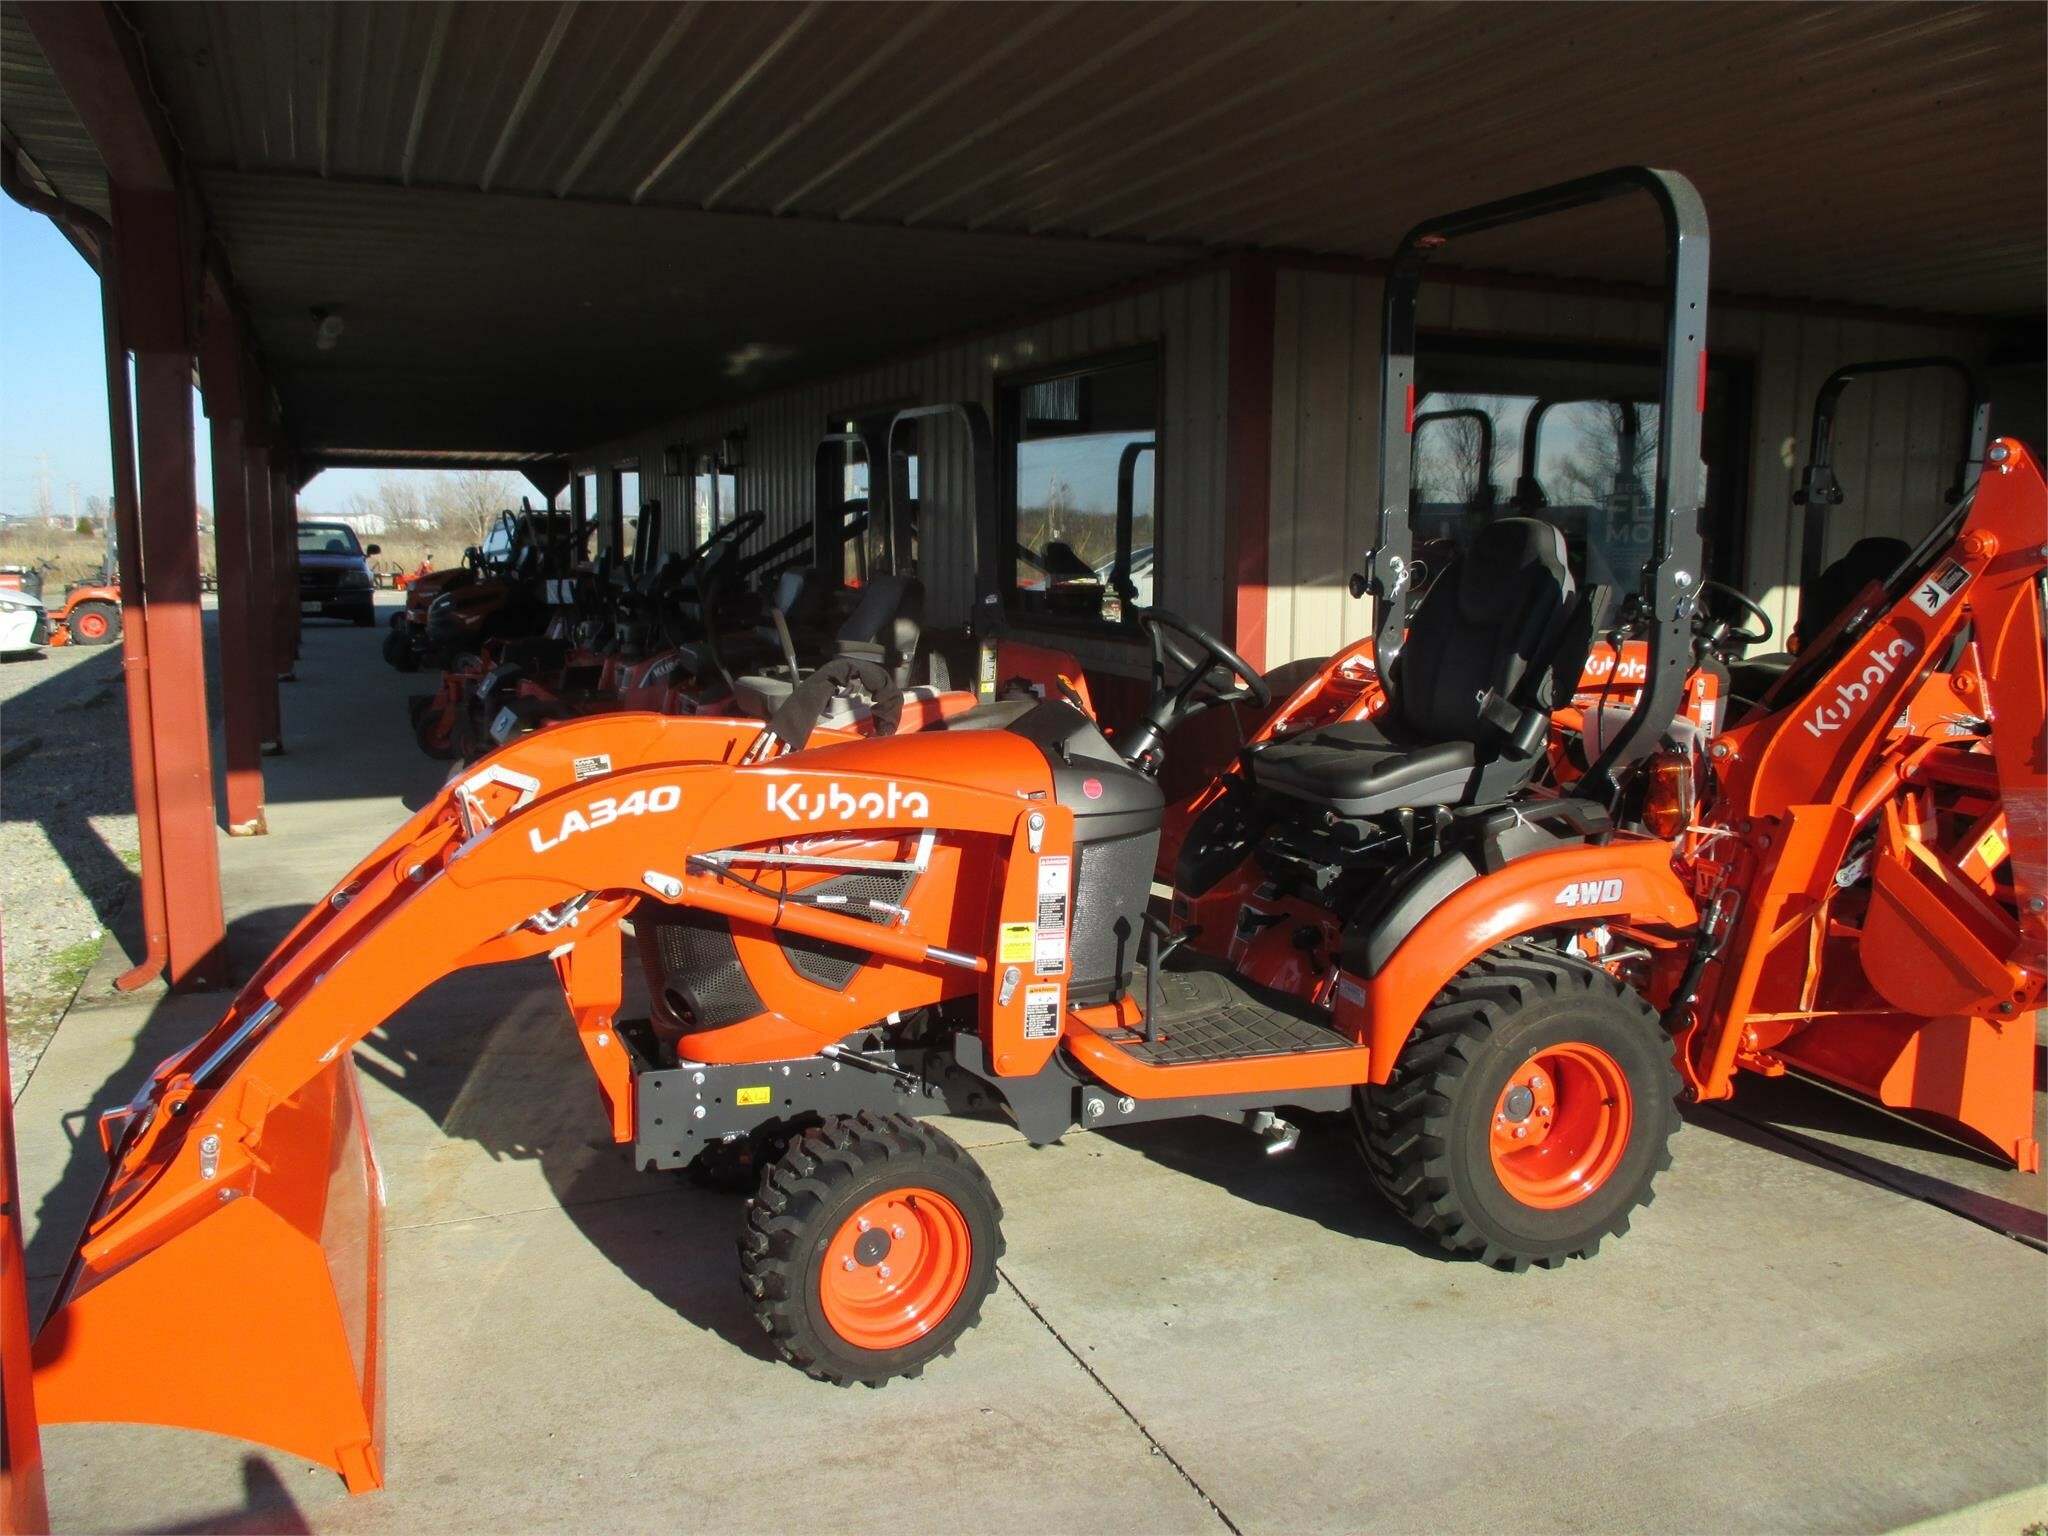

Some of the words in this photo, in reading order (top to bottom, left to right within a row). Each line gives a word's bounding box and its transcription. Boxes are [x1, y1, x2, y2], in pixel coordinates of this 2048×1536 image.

[1803, 638, 1915, 738] Kubota
[528, 785, 681, 853] LA340
[766, 782, 929, 821] Kubota
[1555, 878, 1625, 907] 4WD
